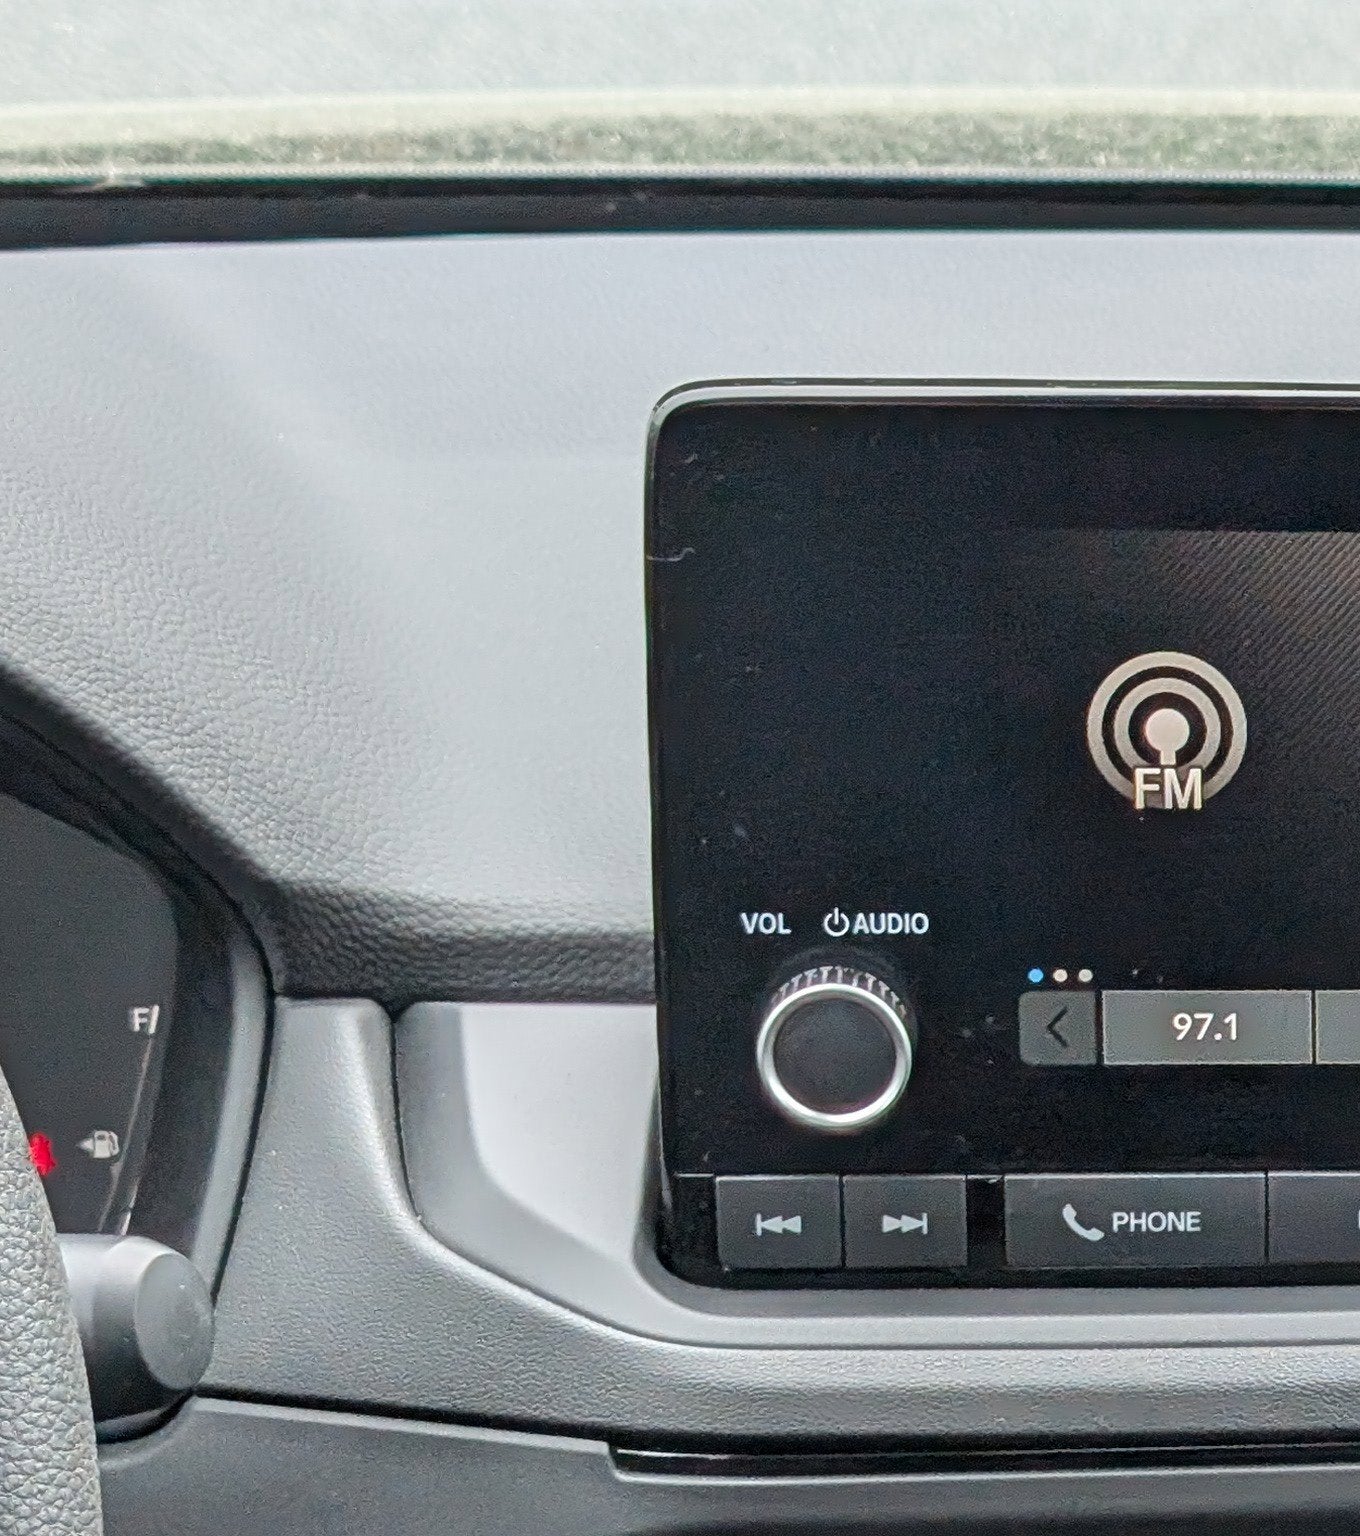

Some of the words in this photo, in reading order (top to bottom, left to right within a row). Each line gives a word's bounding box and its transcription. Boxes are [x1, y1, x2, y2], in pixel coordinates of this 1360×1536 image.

[1134, 767, 1202, 810] FM
[740, 912, 792, 935] VOL
[852, 912, 930, 935] AUDIO
[1172, 1012, 1238, 1041] 97.1
[1111, 1210, 1202, 1233] PHONE
